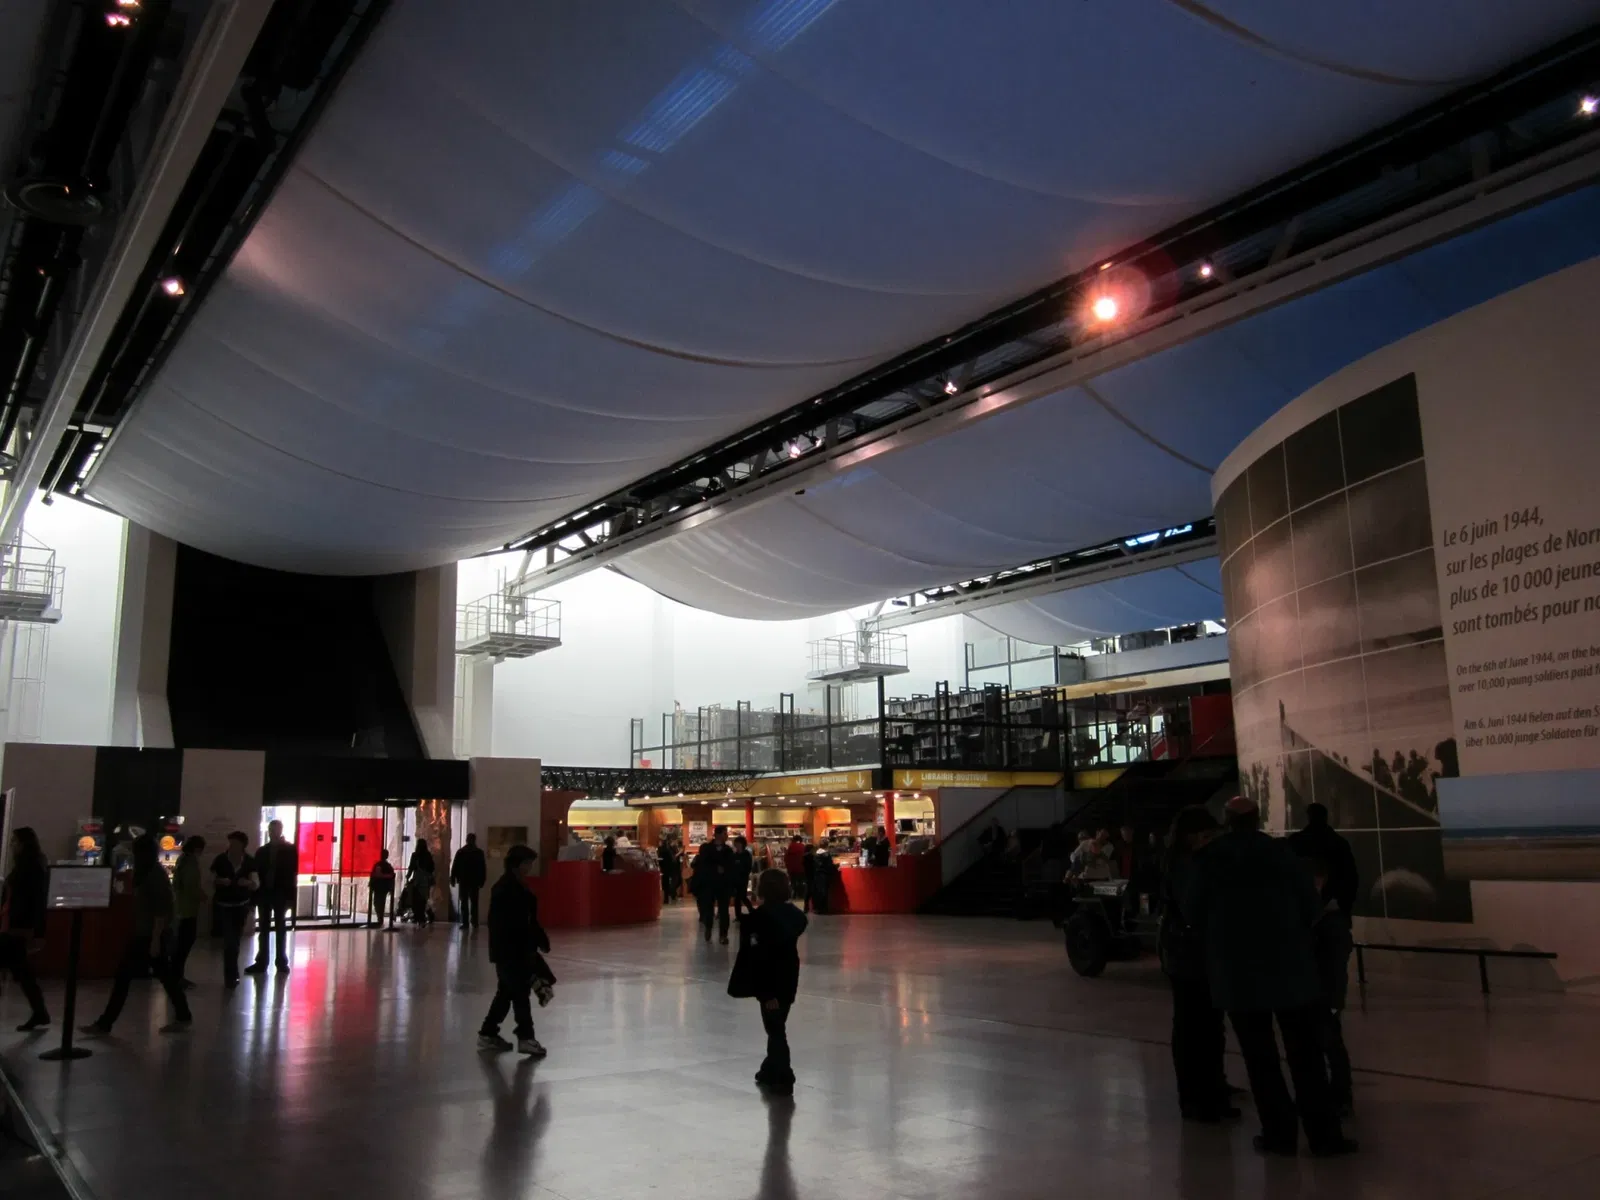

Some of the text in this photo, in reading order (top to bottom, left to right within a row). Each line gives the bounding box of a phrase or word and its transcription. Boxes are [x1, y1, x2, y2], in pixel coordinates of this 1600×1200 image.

[1443, 506, 1544, 547] Le 6 juin 1944,
[1446, 559, 1467, 576] sur
[1470, 552, 1488, 571] les
[1491, 541, 1539, 571] plages
[1543, 533, 1562, 554] de
[1450, 586, 1478, 610] plus
[1481, 580, 1498, 599] de
[1503, 574, 1520, 594] 10
[1523, 567, 1552, 590] 000
[1452, 614, 1482, 635] sont
[1485, 602, 1539, 630] tombés
[1542, 598, 1580, 624] pour
[1456, 664, 1467, 676] On
[1469, 662, 1482, 674] the
[1483, 660, 1496, 672] 6th
[1498, 658, 1508, 670] of
[1508, 656, 1529, 669] June
[1531, 652, 1555, 665] 1944,
[1557, 651, 1569, 661] on
[1571, 647, 1588, 659] the
[1458, 683, 1475, 692] over
[1477, 677, 1505, 690] 10,000
[1506, 674, 1533, 688] young
[1534, 669, 1569, 683] soldiers
[1571, 664, 1593, 680] paid
[1464, 719, 1477, 730] Am
[1478, 717, 1486, 729] 6.
[1487, 716, 1504, 729] Juni
[1506, 712, 1527, 725] 1944
[1529, 710, 1554, 723] fielen
[1556, 707, 1572, 720] auf
[1574, 707, 1592, 719] den
[1465, 724, 1599, 748] über 10.000 junge Soldaten für
